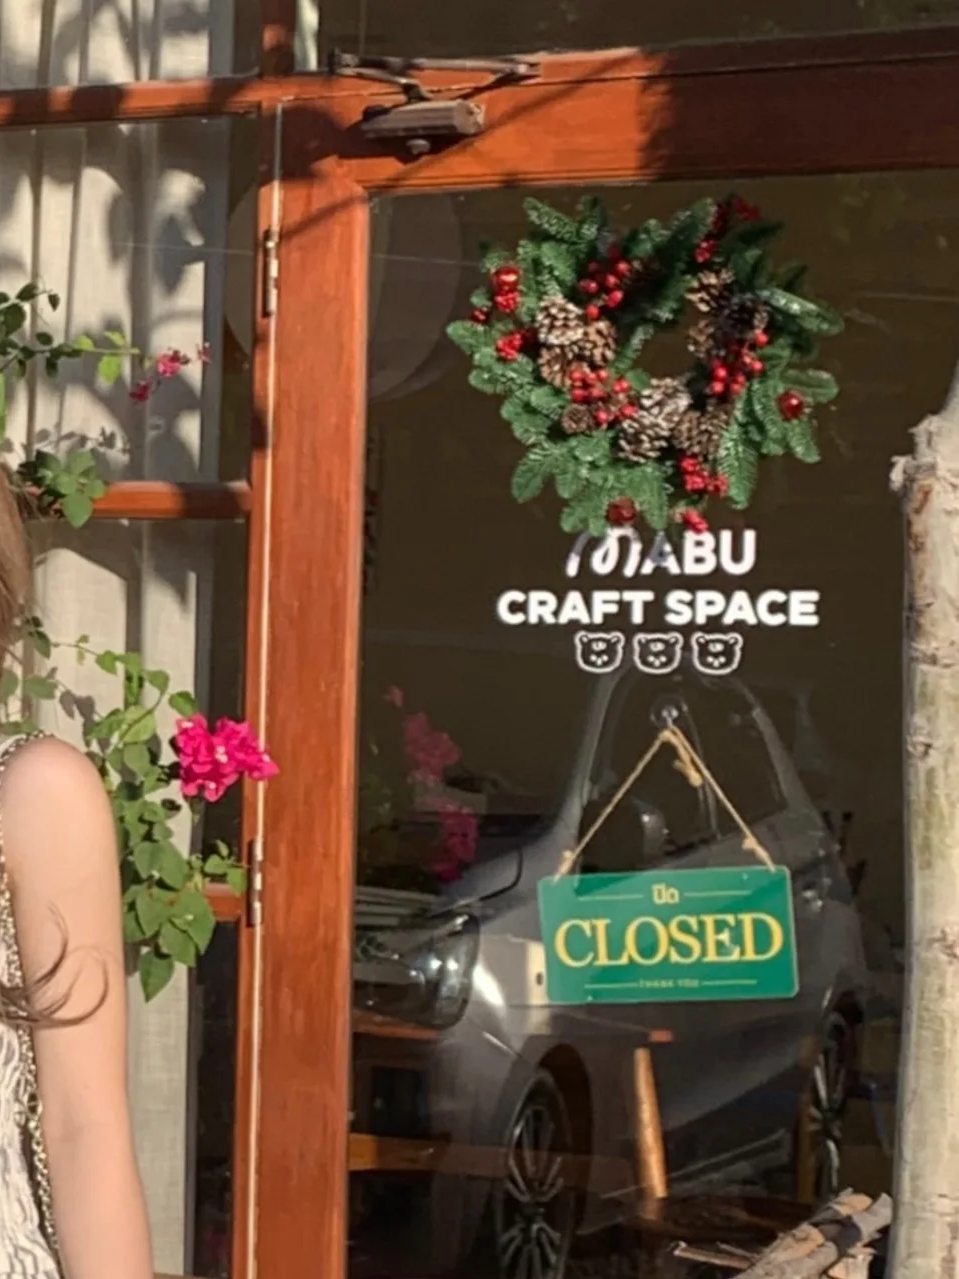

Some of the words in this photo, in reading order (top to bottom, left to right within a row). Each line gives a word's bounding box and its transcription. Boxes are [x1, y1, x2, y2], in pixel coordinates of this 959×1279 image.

[497, 590, 654, 625] CRAFT
[664, 590, 820, 626] SPACE
[555, 912, 784, 968] CLOSED
